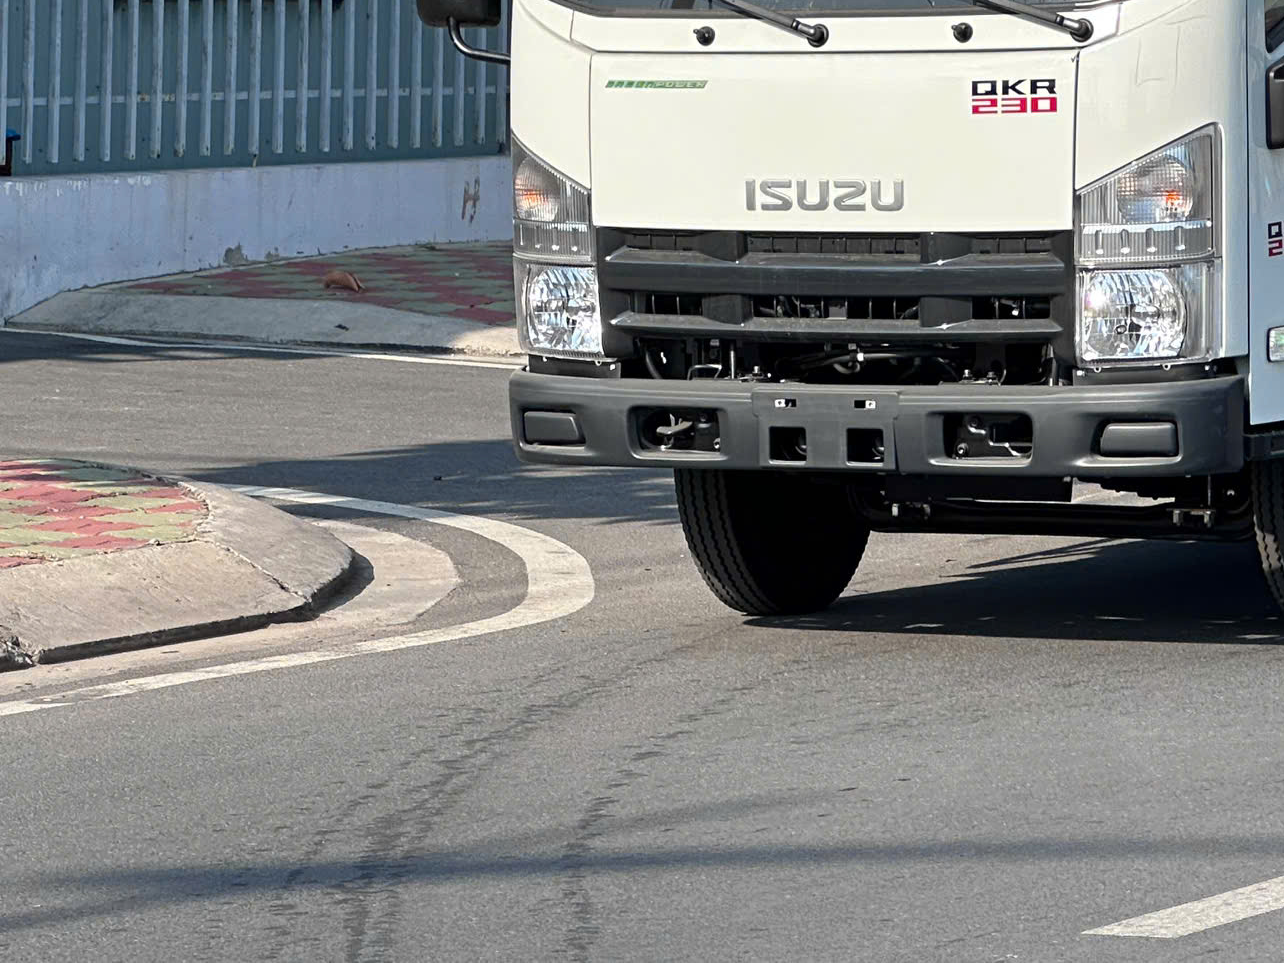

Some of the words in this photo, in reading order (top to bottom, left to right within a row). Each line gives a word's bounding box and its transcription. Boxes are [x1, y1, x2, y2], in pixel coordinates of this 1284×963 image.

[971, 78, 1057, 96] QKR
[971, 96, 1058, 115] 230
[745, 178, 905, 212] ISUZU
